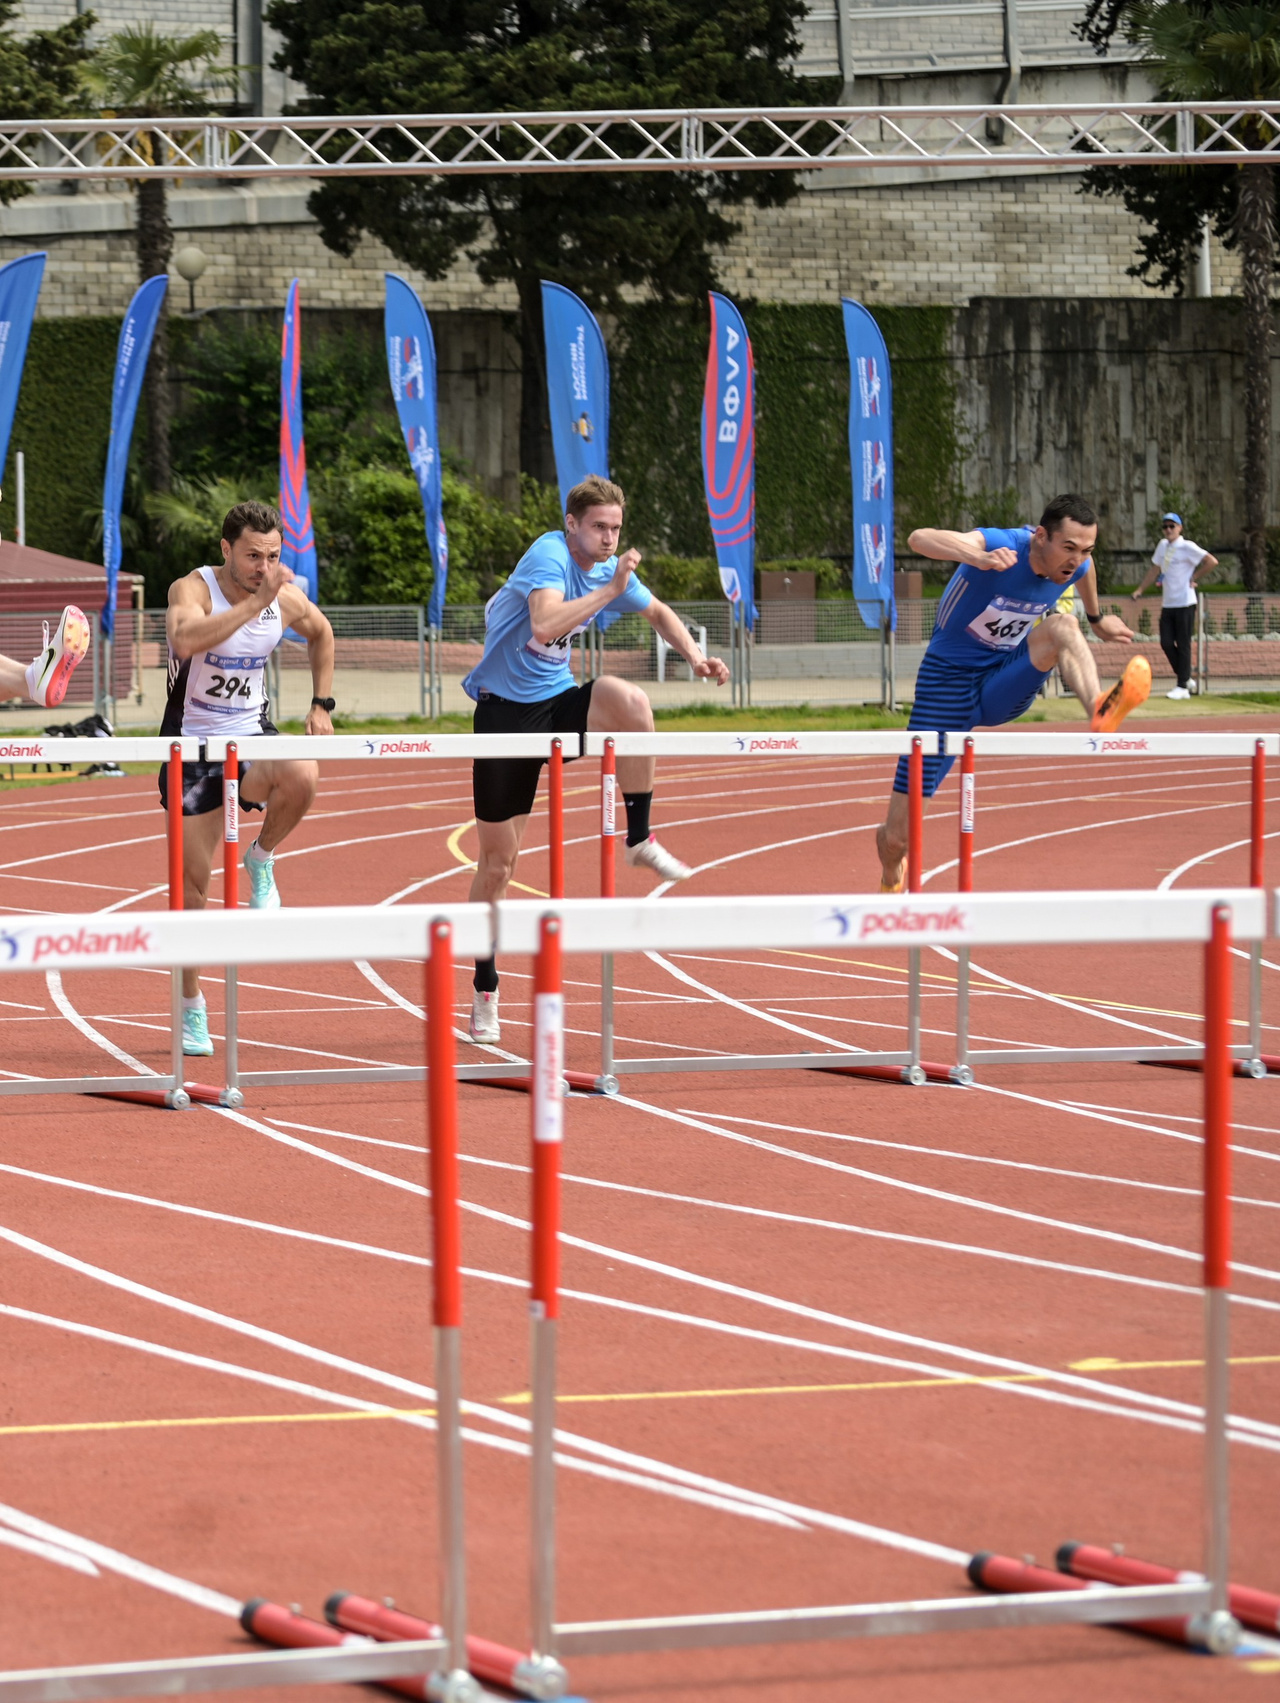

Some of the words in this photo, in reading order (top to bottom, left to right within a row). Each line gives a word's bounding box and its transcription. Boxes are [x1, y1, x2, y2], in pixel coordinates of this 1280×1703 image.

[984, 618, 1030, 638] 463
[205, 675, 251, 700] 294
[379, 740, 433, 755] polanik
[749, 738, 799, 753] polanik
[1101, 738, 1149, 752] polanik
[228, 796, 237, 830] polanik
[859, 906, 967, 939] polanik
[32, 925, 152, 963] polanik
